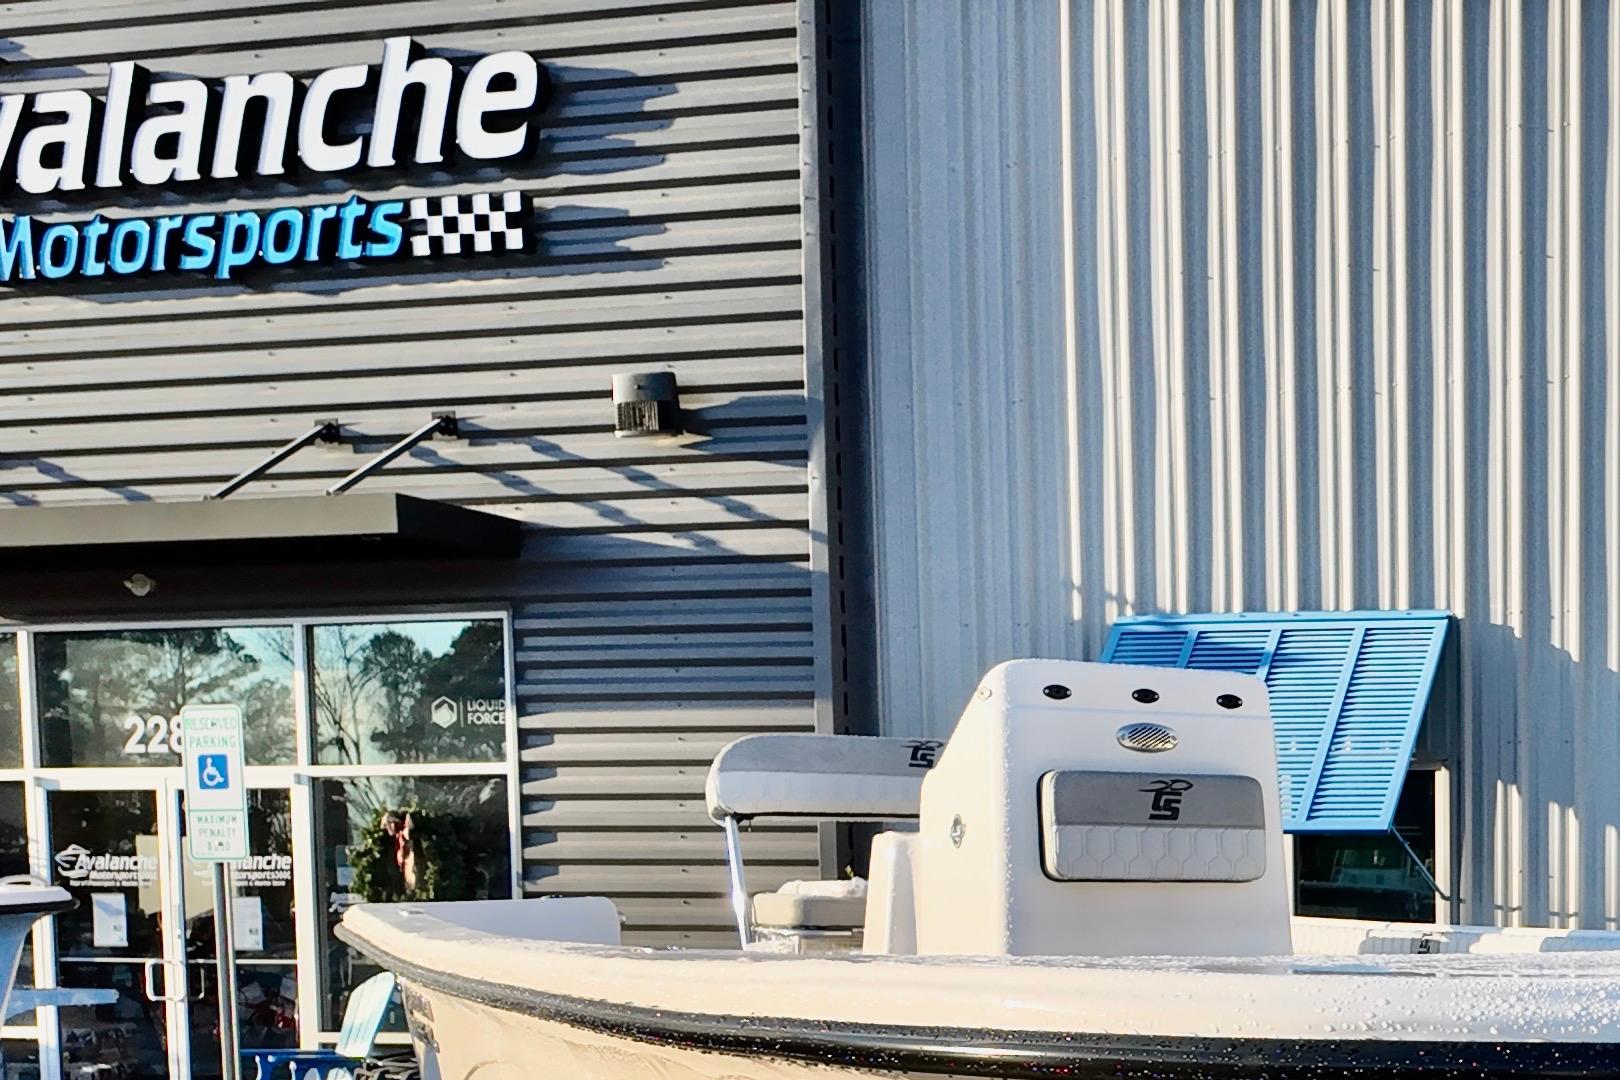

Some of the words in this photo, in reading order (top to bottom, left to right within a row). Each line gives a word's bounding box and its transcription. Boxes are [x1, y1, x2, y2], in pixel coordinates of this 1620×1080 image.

[0, 196, 403, 282] Motorsports
[467, 699, 506, 711] LIQUID
[467, 712, 506, 725] FORCE
[190, 736, 236, 748] PARKING
[197, 815, 237, 824] MAXIMUM
[199, 828, 236, 838] PENALTY
[75, 853, 159, 871] Avalanche
